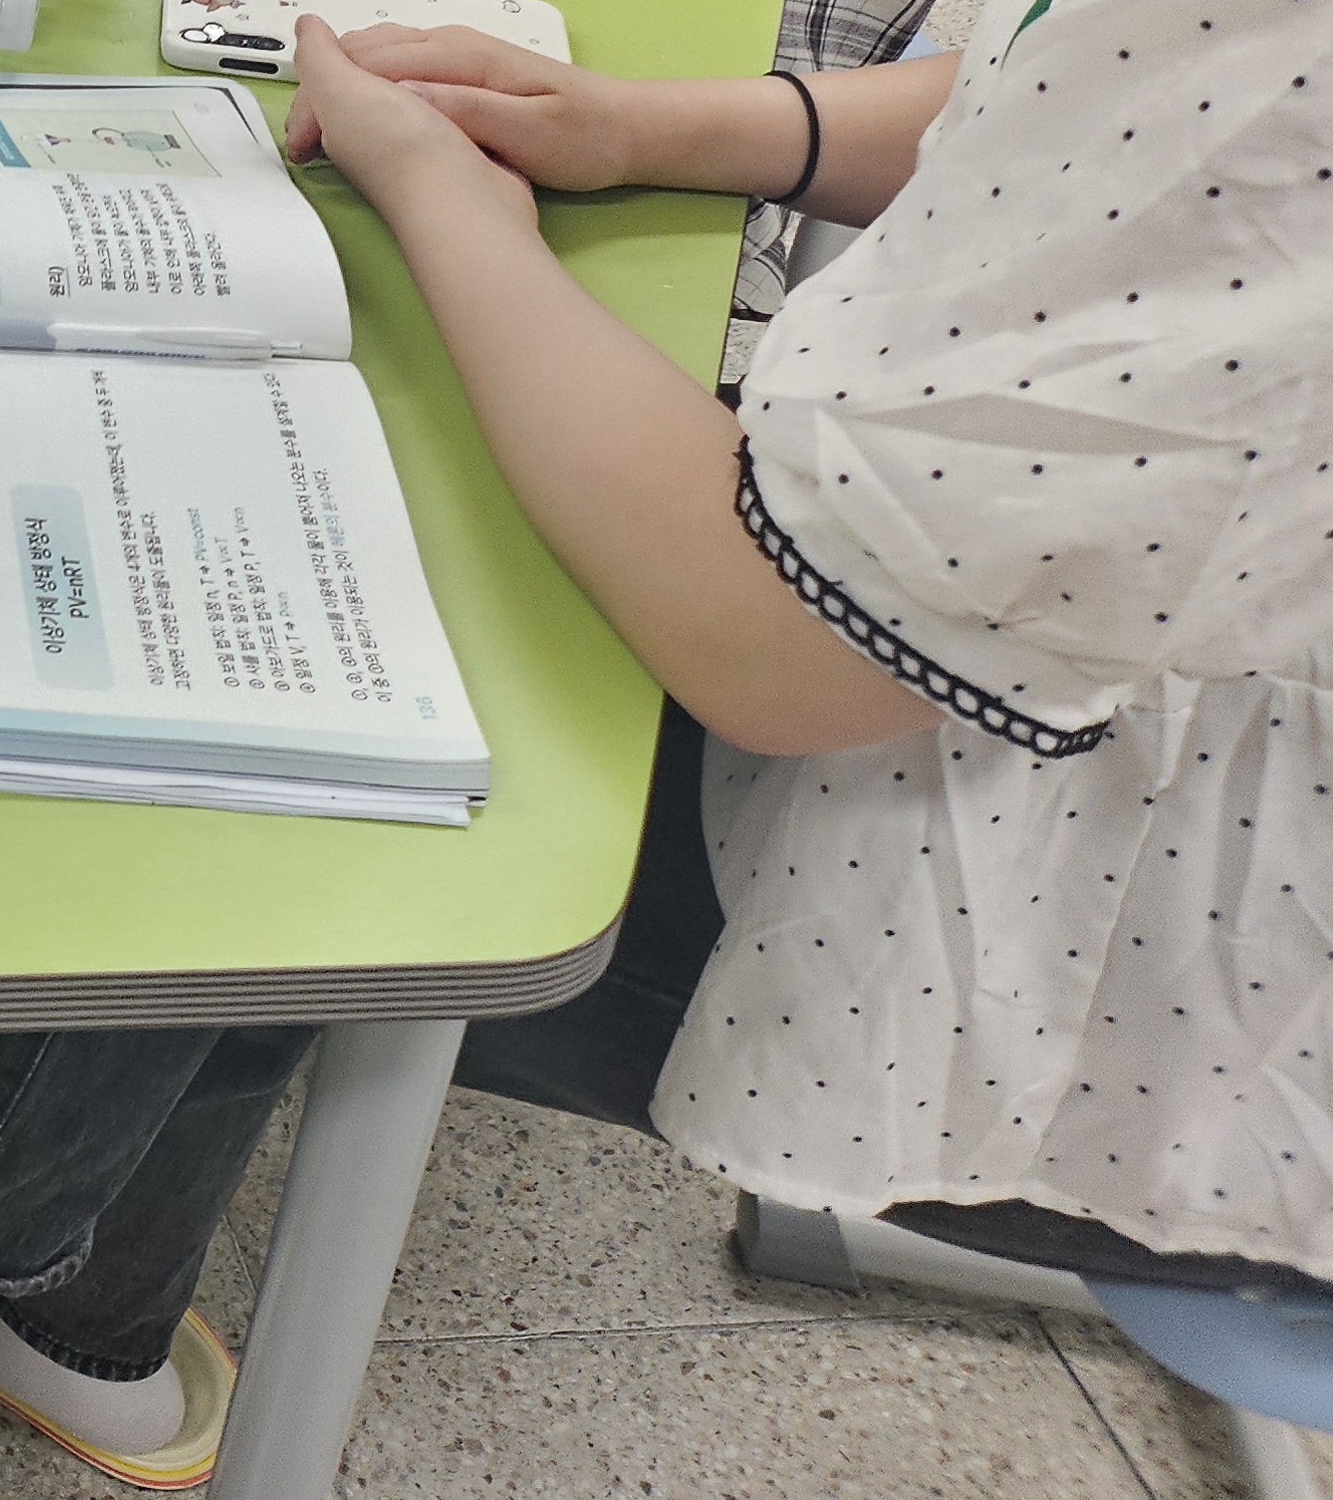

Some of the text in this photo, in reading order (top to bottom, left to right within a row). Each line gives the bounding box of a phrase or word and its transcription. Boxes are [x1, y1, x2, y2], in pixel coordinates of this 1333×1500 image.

[74, 244, 93, 287] 암모니아
[94, 239, 116, 291] 플라스크에
[117, 240, 139, 293] 암모니아가
[162, 249, 181, 269] 인해
[48, 267, 66, 298] 원리)
[145, 271, 161, 294] 내부
[167, 272, 184, 295] 이로
[188, 262, 207, 296] 아래쪽
[270, 390, 283, 398] 수
[280, 429, 301, 458] 분수를
[290, 462, 308, 492] 나오는
[117, 509, 137, 541] 변수로
[305, 529, 325, 550] 물이
[311, 553, 329, 575] 각각
[335, 550, 353, 571] 것이
[24, 517, 67, 654] 이상기체 상태 방정식
[60, 556, 92, 619] PV=nRT
[128, 575, 152, 616] 방정식은
[151, 569, 175, 610] 원리들이
[200, 578, 215, 586] T
[247, 574, 265, 595] 일정
[318, 578, 339, 608] 이용해
[343, 575, 365, 615] 이용되는
[203, 601, 225, 622] 일정
[228, 603, 249, 624] 일정
[253, 598, 272, 621] 법칙:
[137, 619, 157, 640] 상태
[159, 613, 180, 645] 다양한
[327, 612, 351, 642] 원리를
[354, 618, 377, 649] 원리가
[141, 643, 164, 685] 이상기체
[216, 652, 236, 674] 보일
[241, 655, 261, 676] 샤를
[259, 625, 286, 678] 아보가드로
[291, 658, 313, 679] 일정
[371, 677, 390, 688] 중
[375, 691, 392, 702] 이
